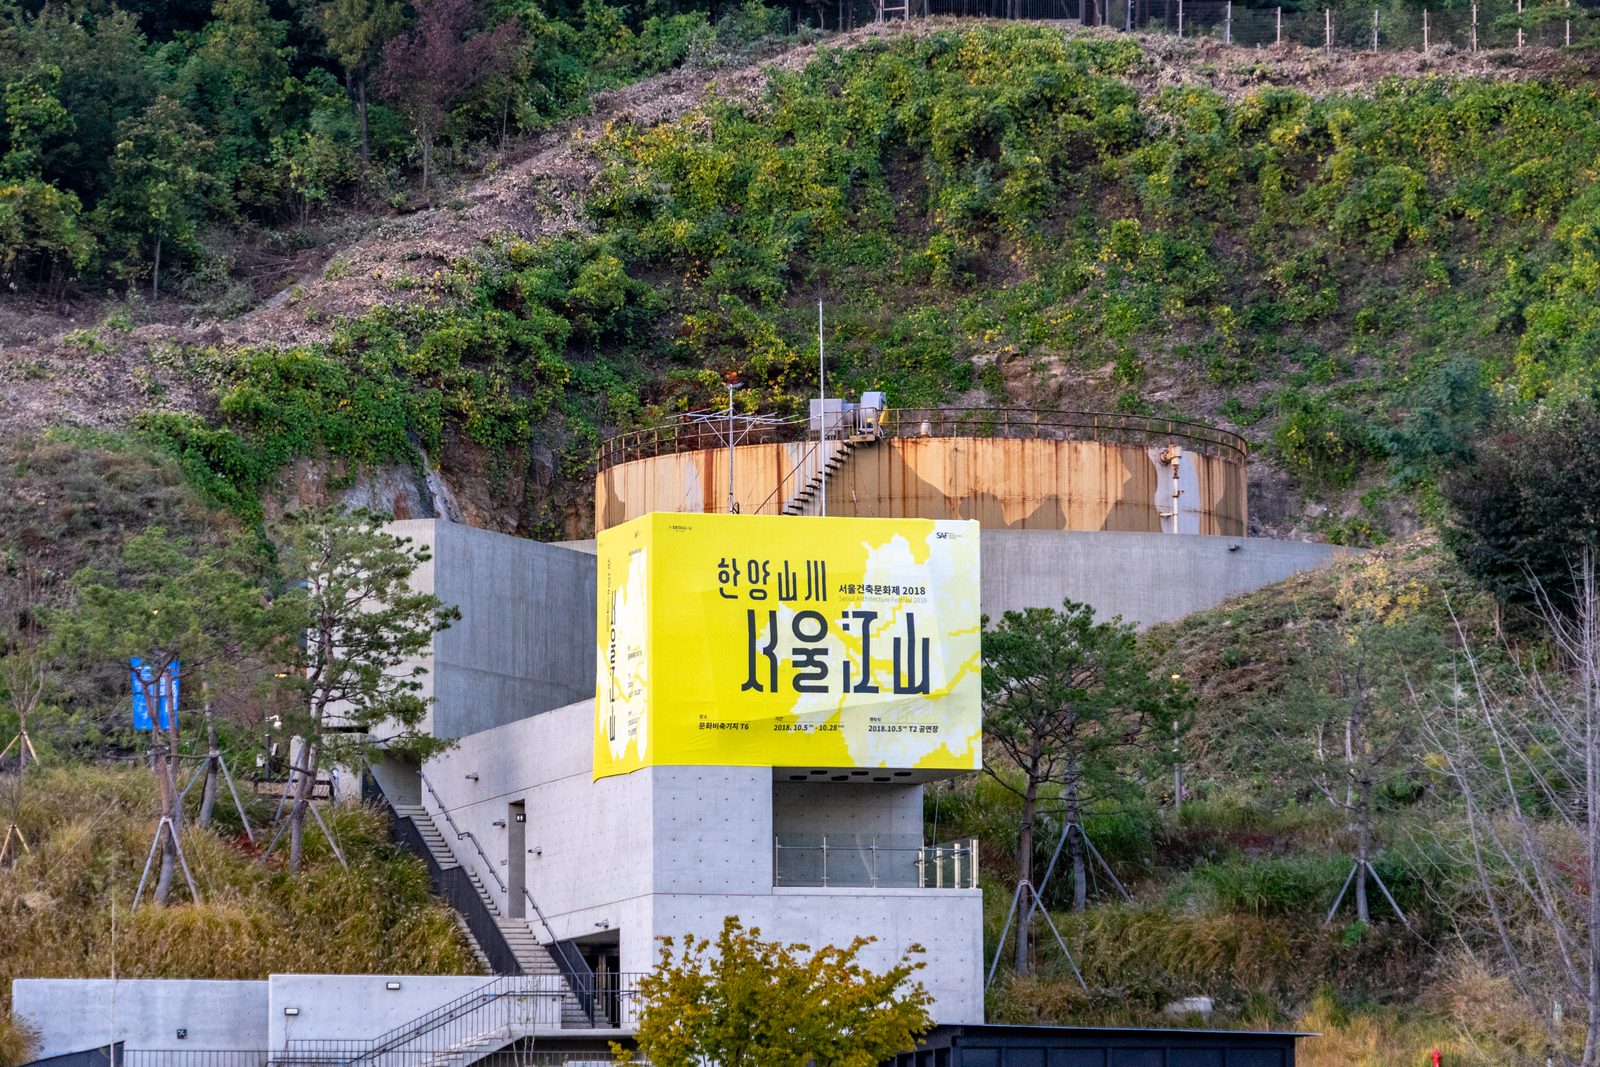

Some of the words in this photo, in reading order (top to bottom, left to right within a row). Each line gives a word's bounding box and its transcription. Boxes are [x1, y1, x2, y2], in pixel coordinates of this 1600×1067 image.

[936, 531, 949, 539] SAF
[839, 584, 900, 595] 서울건축문화제
[902, 586, 926, 595] 2018
[856, 595, 890, 603] Architecture
[913, 596, 928, 604] 2018
[699, 722, 739, 730] 문화비축기지
[909, 725, 917, 733] T2
[919, 725, 939, 734] 공연장
